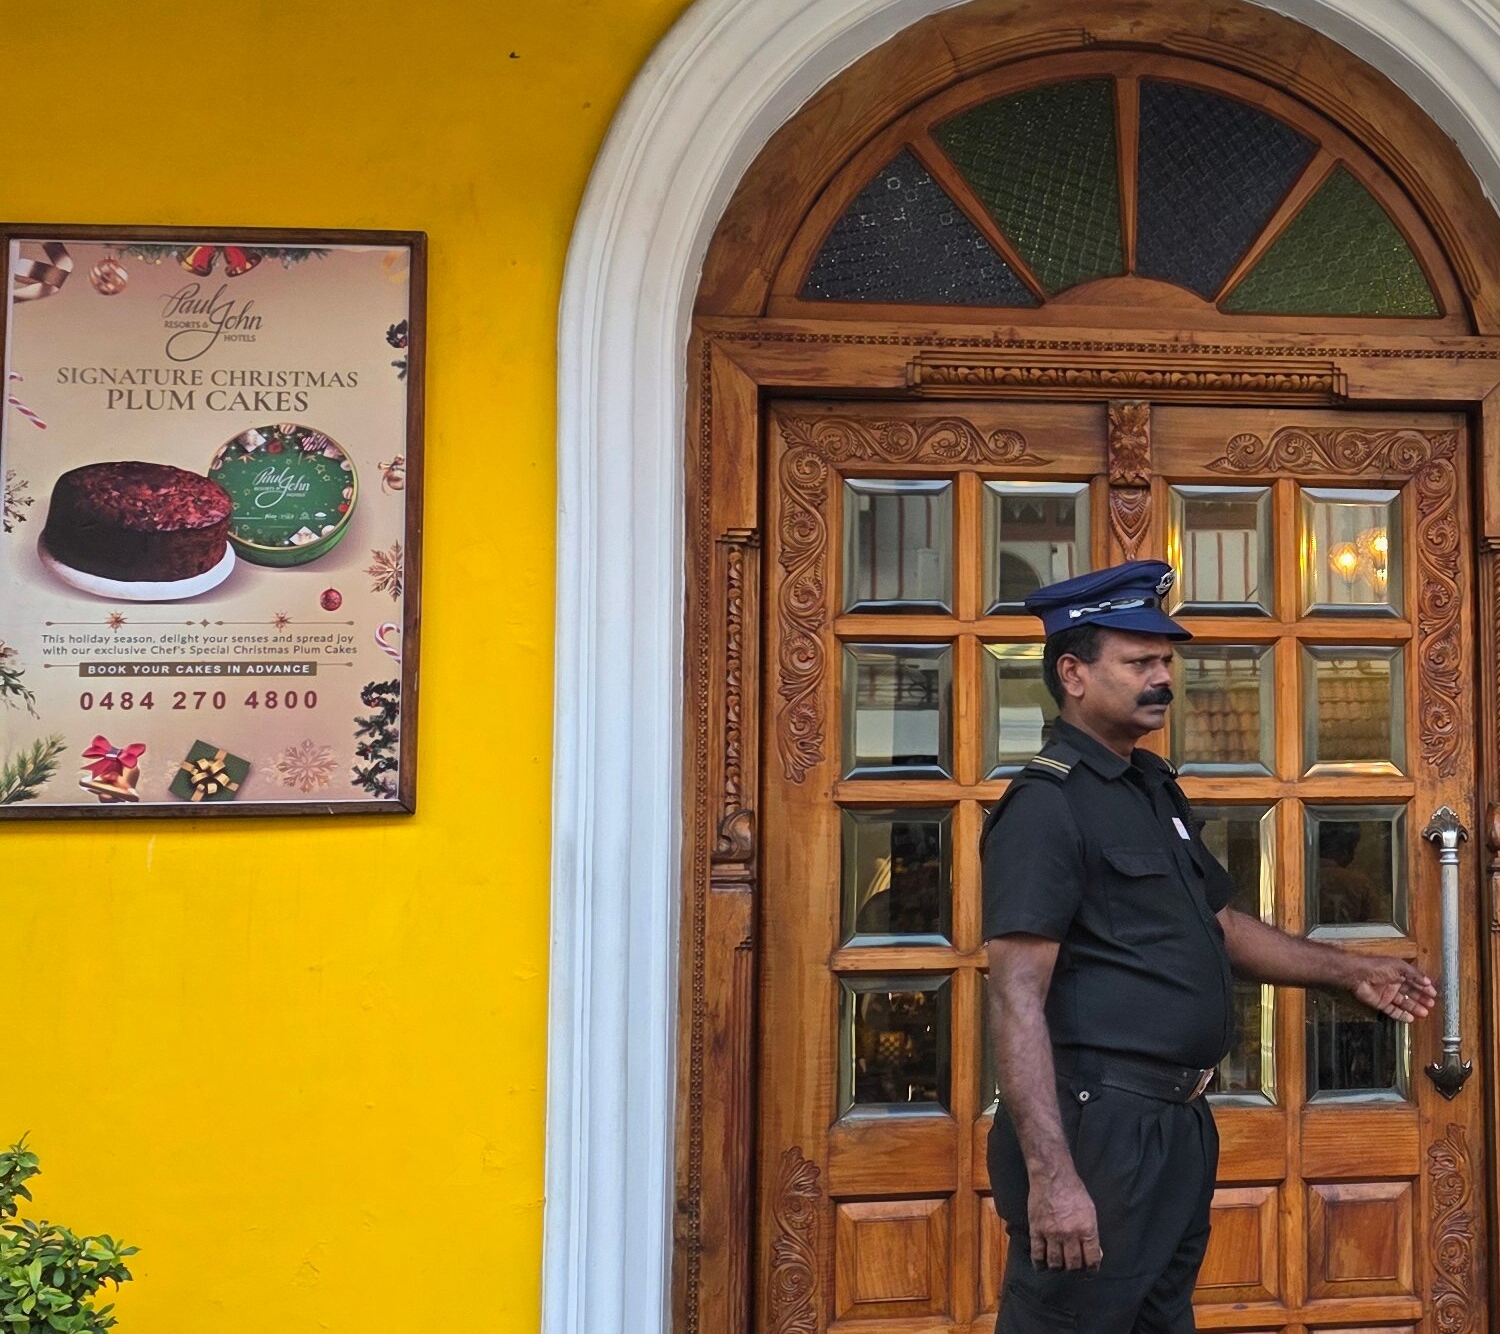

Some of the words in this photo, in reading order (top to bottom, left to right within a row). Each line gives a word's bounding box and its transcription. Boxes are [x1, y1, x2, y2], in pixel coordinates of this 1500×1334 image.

[159, 282, 228, 319] Paul
[164, 320, 201, 329] RESORTS
[166, 299, 263, 363] John
[223, 334, 257, 343] HOTELS
[57, 367, 204, 386] SIGNATURE
[210, 369, 359, 388] CHRISTMAS
[106, 388, 197, 411] PLUM
[205, 389, 309, 413] CAKES
[42, 634, 65, 644] This
[69, 634, 111, 645] holiday
[160, 633, 200, 645] delight
[203, 635, 229, 645] your
[232, 635, 269, 644] senses
[272, 634, 293, 644] and
[296, 634, 334, 645] spread
[336, 634, 354, 645] joy
[42, 645, 68, 656] with
[71, 647, 91, 656] our
[94, 645, 147, 656] exclusive
[150, 645, 186, 656] Chef's
[190, 645, 230, 657] Special
[233, 645, 290, 655] Christmas
[293, 645, 321, 655] Plum
[324, 645, 358, 655] Cakes
[88, 665, 127, 675] BOOK
[133, 665, 170, 674] YOUR
[175, 665, 222, 674] CAKES
[227, 665, 241, 674] IN
[246, 664, 311, 674] ADVANCE
[80, 691, 155, 711] 0484
[172, 690, 227, 711] 270
[244, 690, 318, 710] 4800
